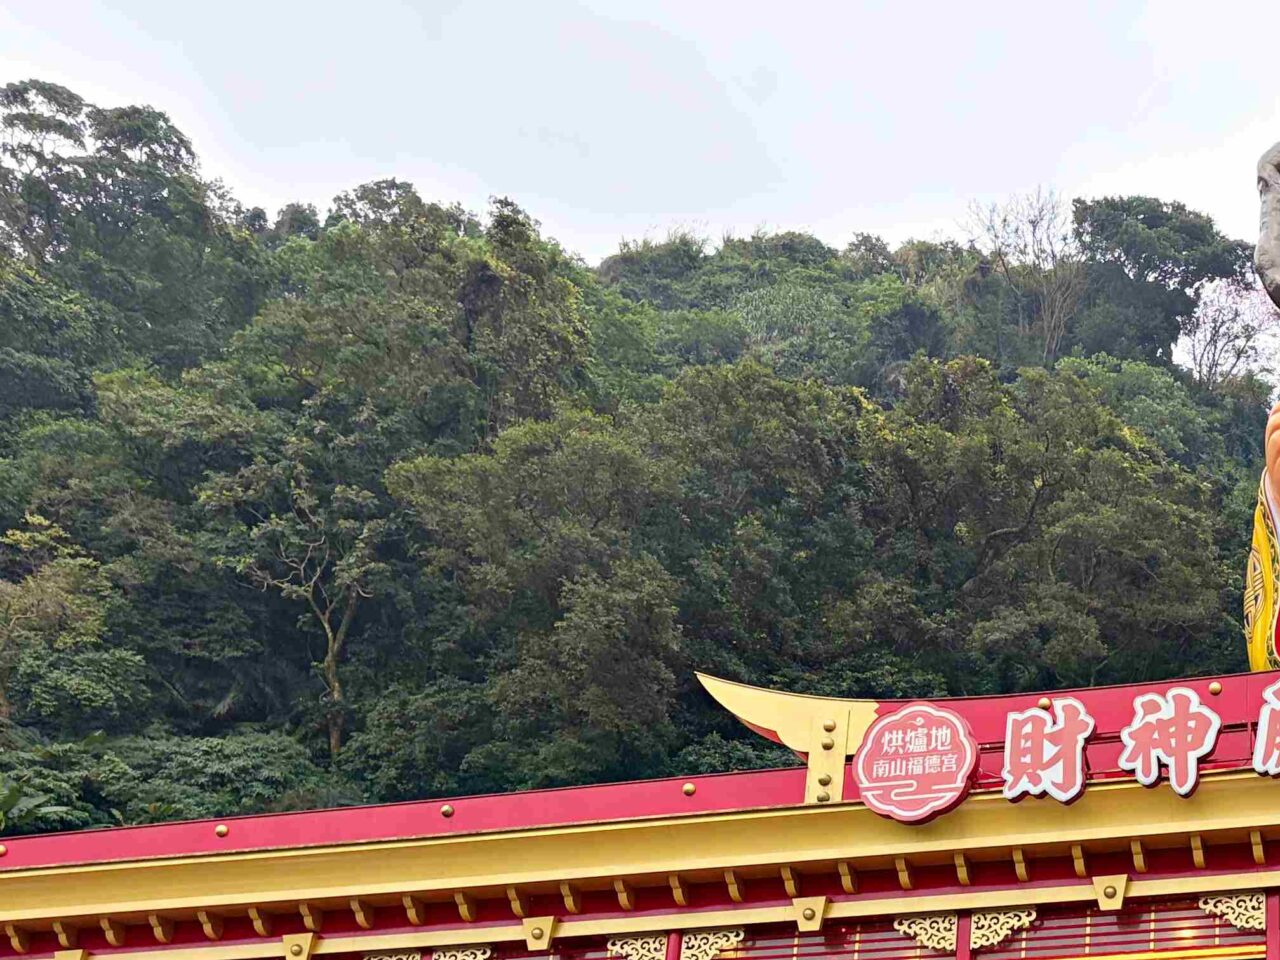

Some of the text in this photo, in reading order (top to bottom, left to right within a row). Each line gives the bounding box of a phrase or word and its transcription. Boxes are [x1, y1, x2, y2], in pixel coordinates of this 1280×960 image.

[881, 726, 952, 755] 烘爐地
[872, 754, 958, 779] 南山福德宮
